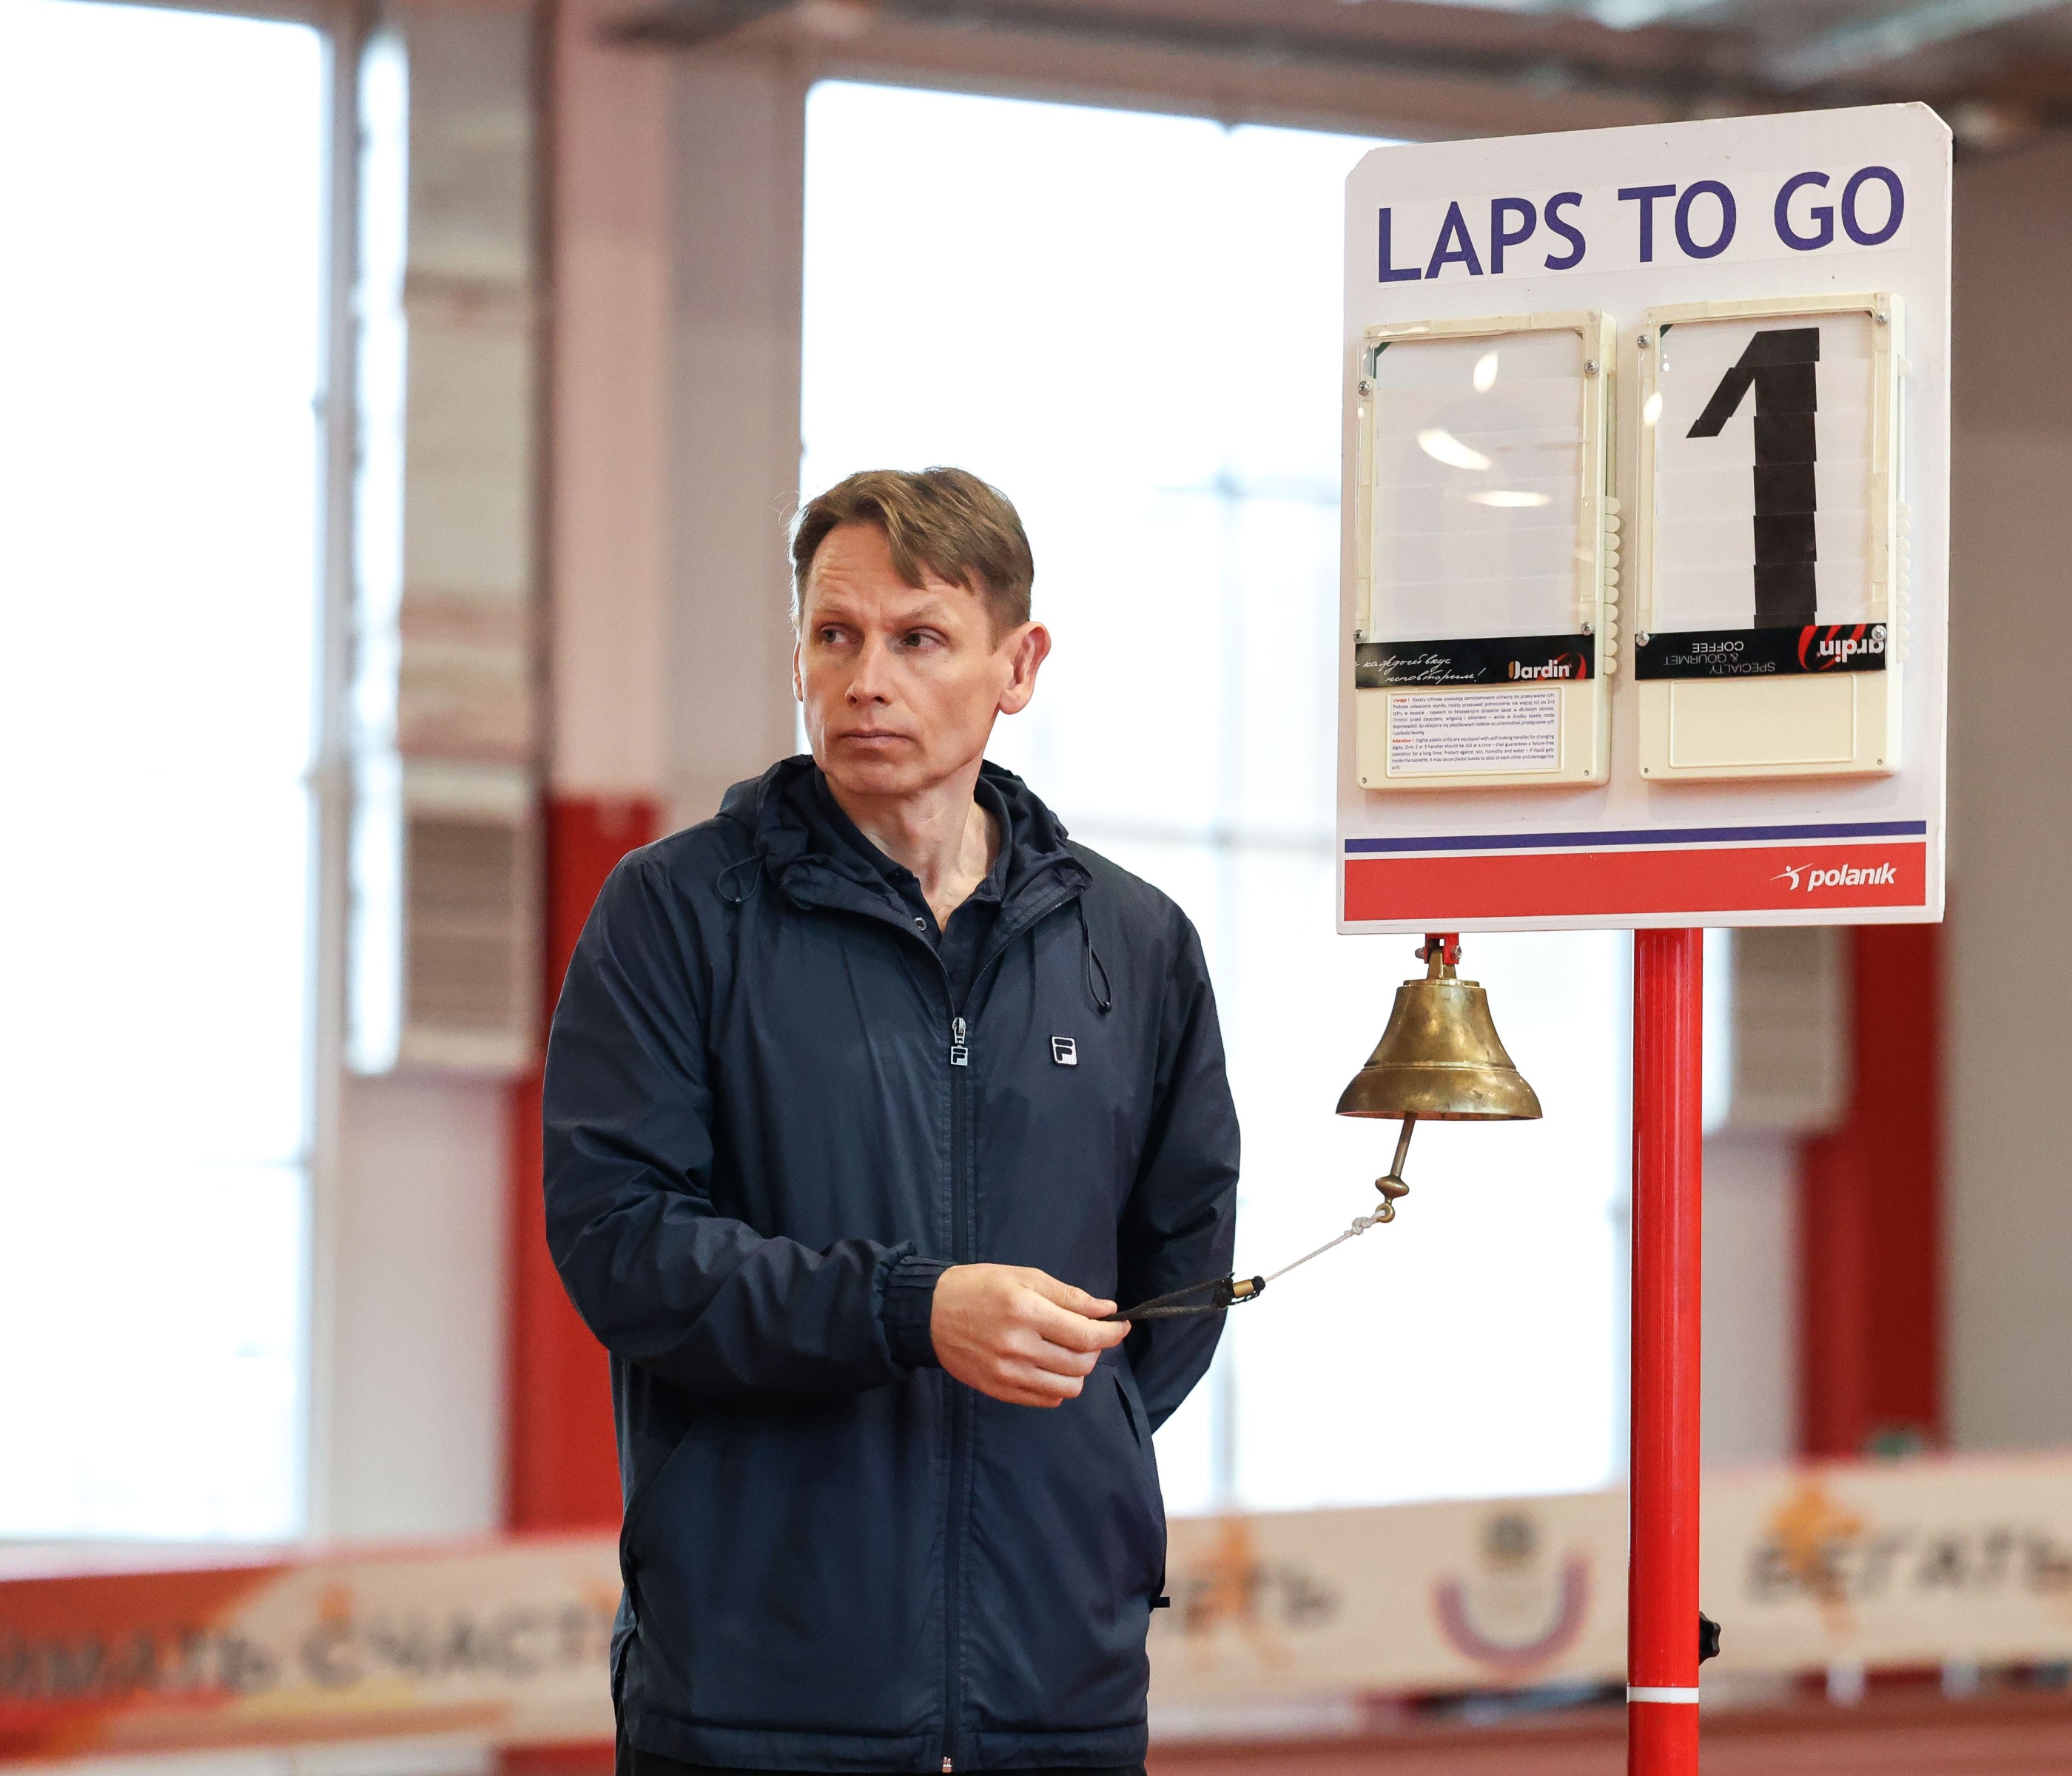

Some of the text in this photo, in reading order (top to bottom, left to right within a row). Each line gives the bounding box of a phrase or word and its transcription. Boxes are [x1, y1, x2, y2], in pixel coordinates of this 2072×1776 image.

[1379, 166, 1905, 282] LAPS TO GO
[1686, 327, 1820, 629] 1
[1692, 641, 1744, 652] COFFEE
[1664, 653, 1727, 666] GOURMET
[1709, 662, 1776, 674] SPECIALTY
[1508, 660, 1570, 680] Jardin
[1807, 862, 1897, 892] polanik
